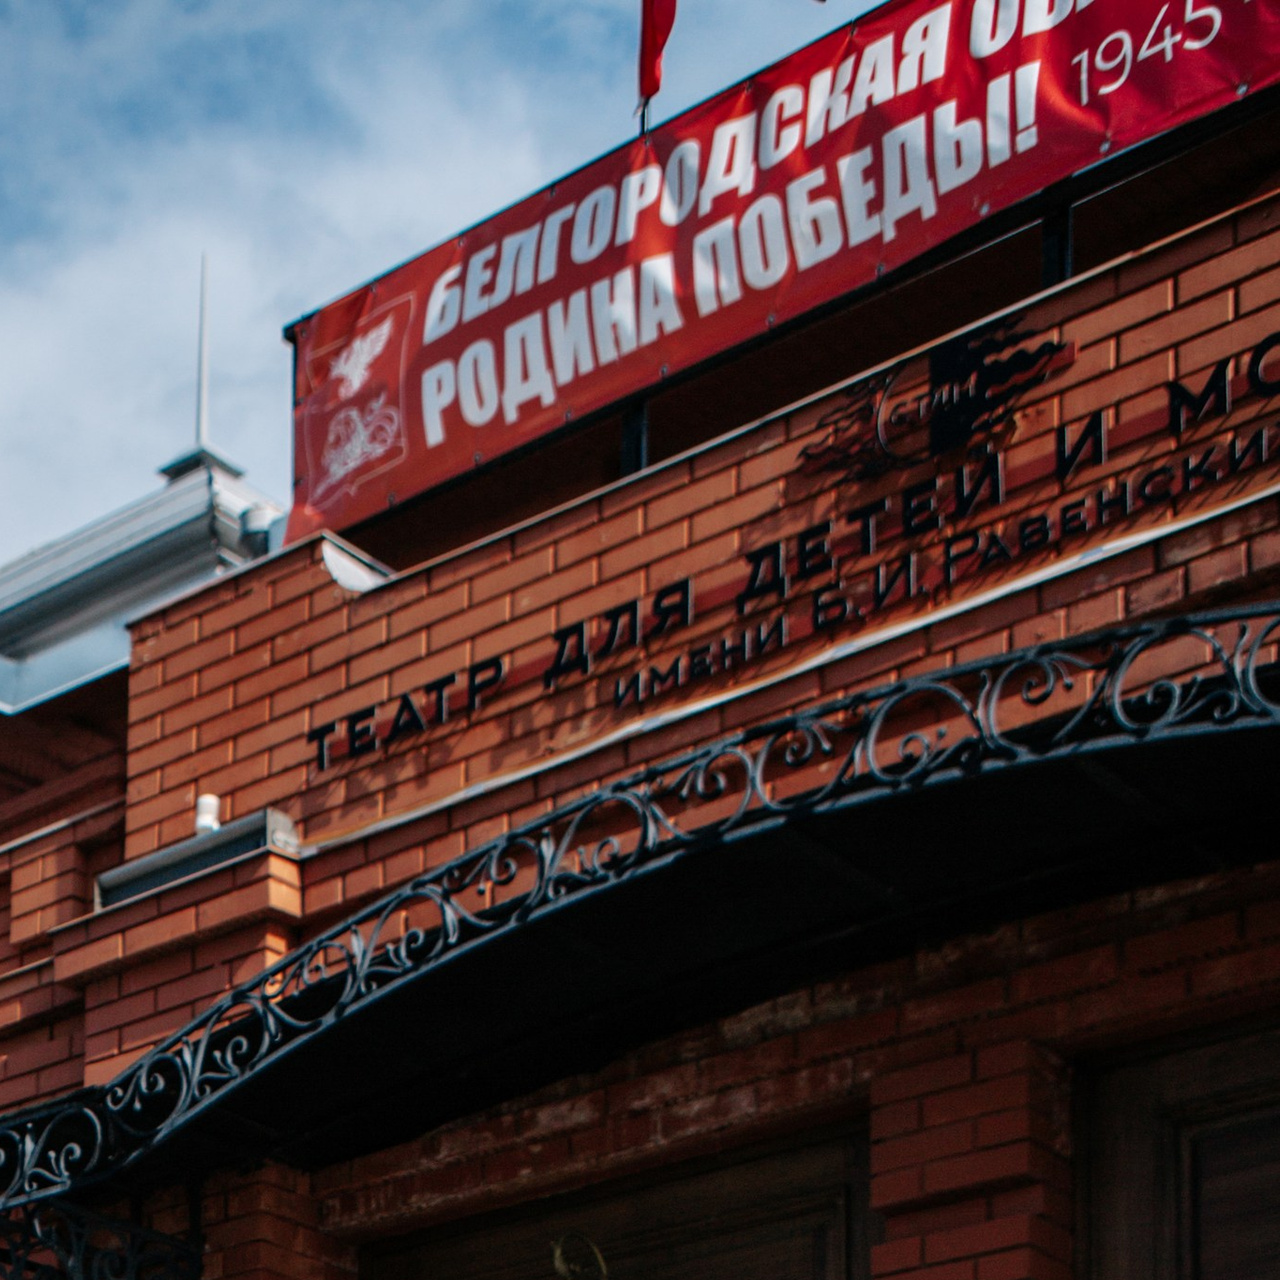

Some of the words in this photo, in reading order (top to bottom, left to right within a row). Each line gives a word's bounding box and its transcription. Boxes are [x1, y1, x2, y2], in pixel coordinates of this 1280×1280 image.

[423, 2, 952, 345] БЕЛГОРОДСКАЯ
[1072, 0, 1221, 107] 1945
[421, 252, 685, 449] РОДИНА
[692, 60, 1040, 317] ПОБЕДЫ!
[307, 657, 505, 770] ТЕАТР
[544, 579, 693, 690] ДЛЯ
[737, 440, 1004, 614] ДЕТЕЙ
[1056, 410, 1107, 493] И
[615, 613, 788, 707] ИМЕНИ
